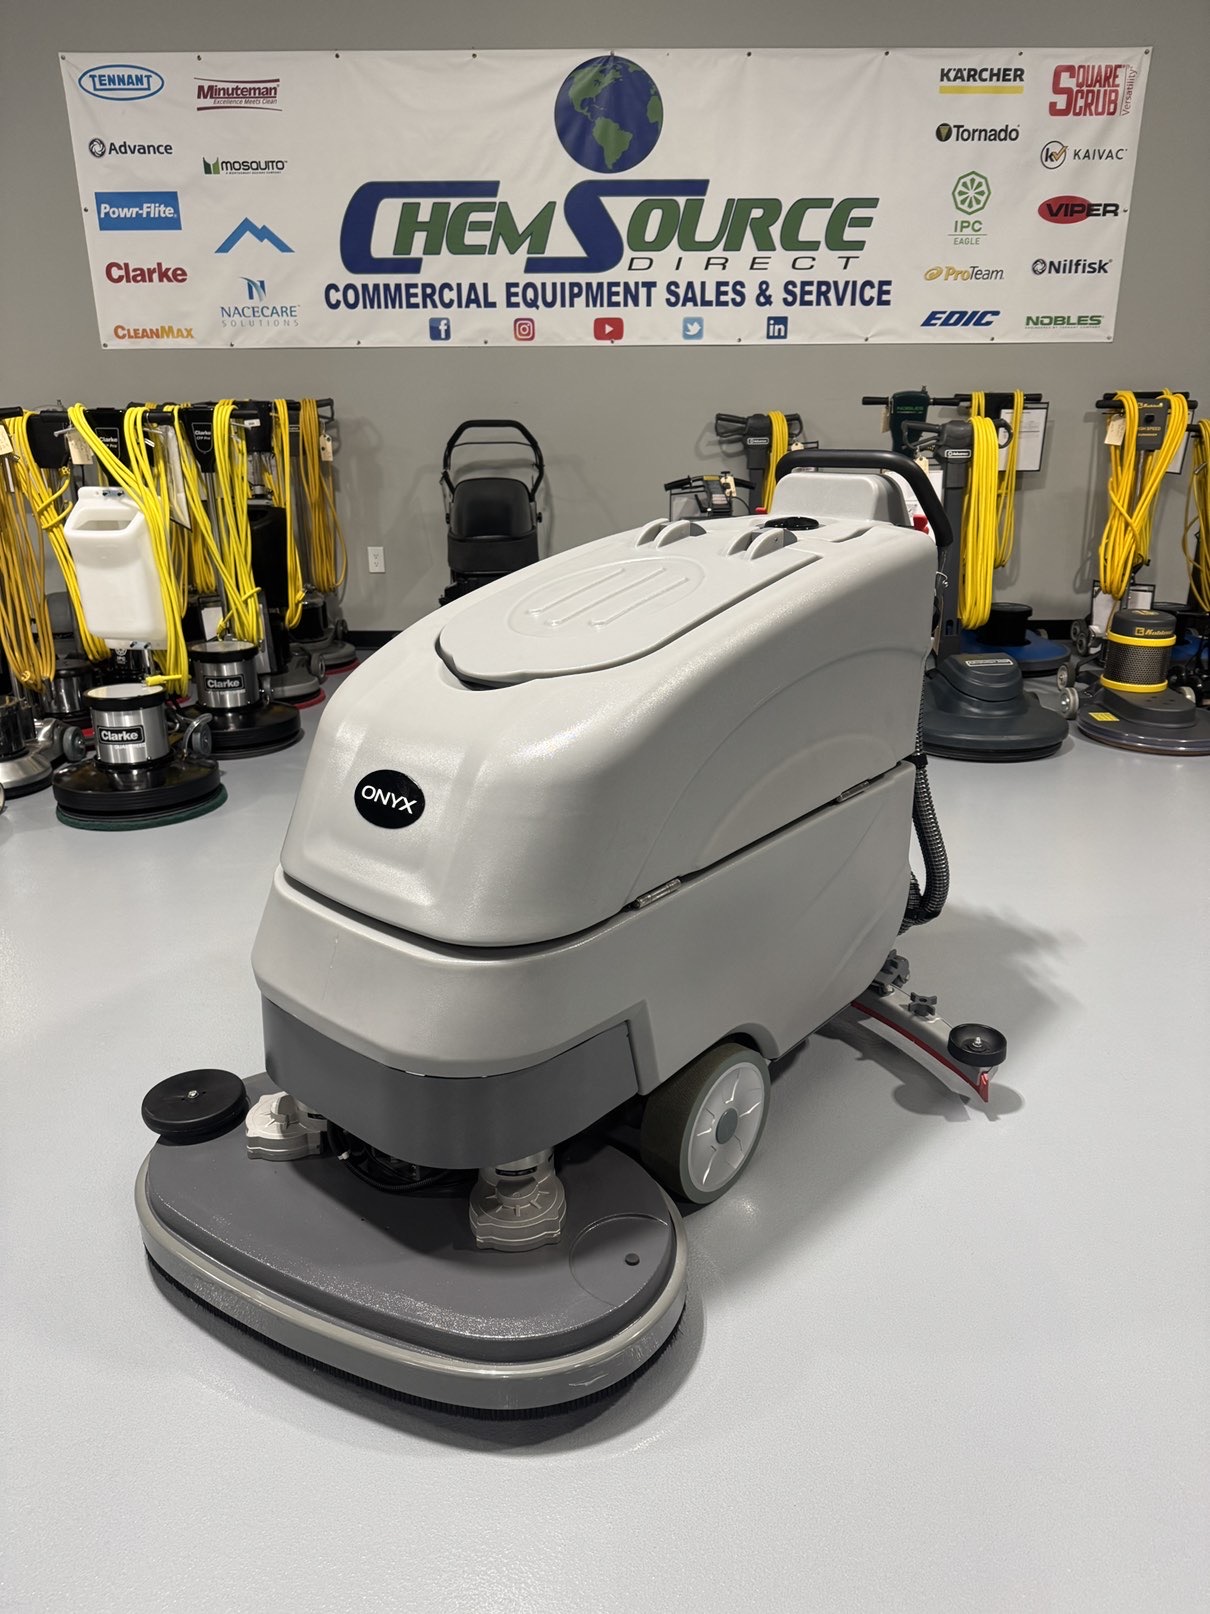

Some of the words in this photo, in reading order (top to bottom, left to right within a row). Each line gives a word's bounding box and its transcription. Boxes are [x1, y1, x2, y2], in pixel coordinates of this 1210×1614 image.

[89, 74, 153, 90] TENNANT
[940, 68, 1025, 82] KÄRCHER
[197, 85, 278, 99] Minuteman
[1122, 67, 1138, 116] Versatility
[953, 125, 1019, 142] Tornado
[108, 141, 173, 155] Advance
[1073, 149, 1124, 160] KAIVAC
[101, 204, 175, 218] Powr-Flite
[1046, 203, 1120, 217] VIPER
[954, 221, 983, 232] IPC
[628, 256, 860, 271] DIRECT
[1048, 259, 1108, 274] Nilfisk
[105, 262, 188, 283] Clarke
[944, 266, 1003, 281] ProTeam
[324, 283, 497, 309] COMMERCIAL
[505, 281, 657, 311] EQUIPMENT
[665, 281, 746, 308] SALES
[755, 281, 773, 308] &
[782, 280, 892, 307] SERVICE
[220, 305, 297, 318] NACECARE
[921, 311, 1000, 326] EDIC
[222, 319, 299, 327] SOLUTIONS
[1026, 315, 1102, 326] NOBLES
[207, 679, 240, 688] Clarke
[101, 729, 138, 740] Clarke
[362, 785, 417, 814] ONYX
